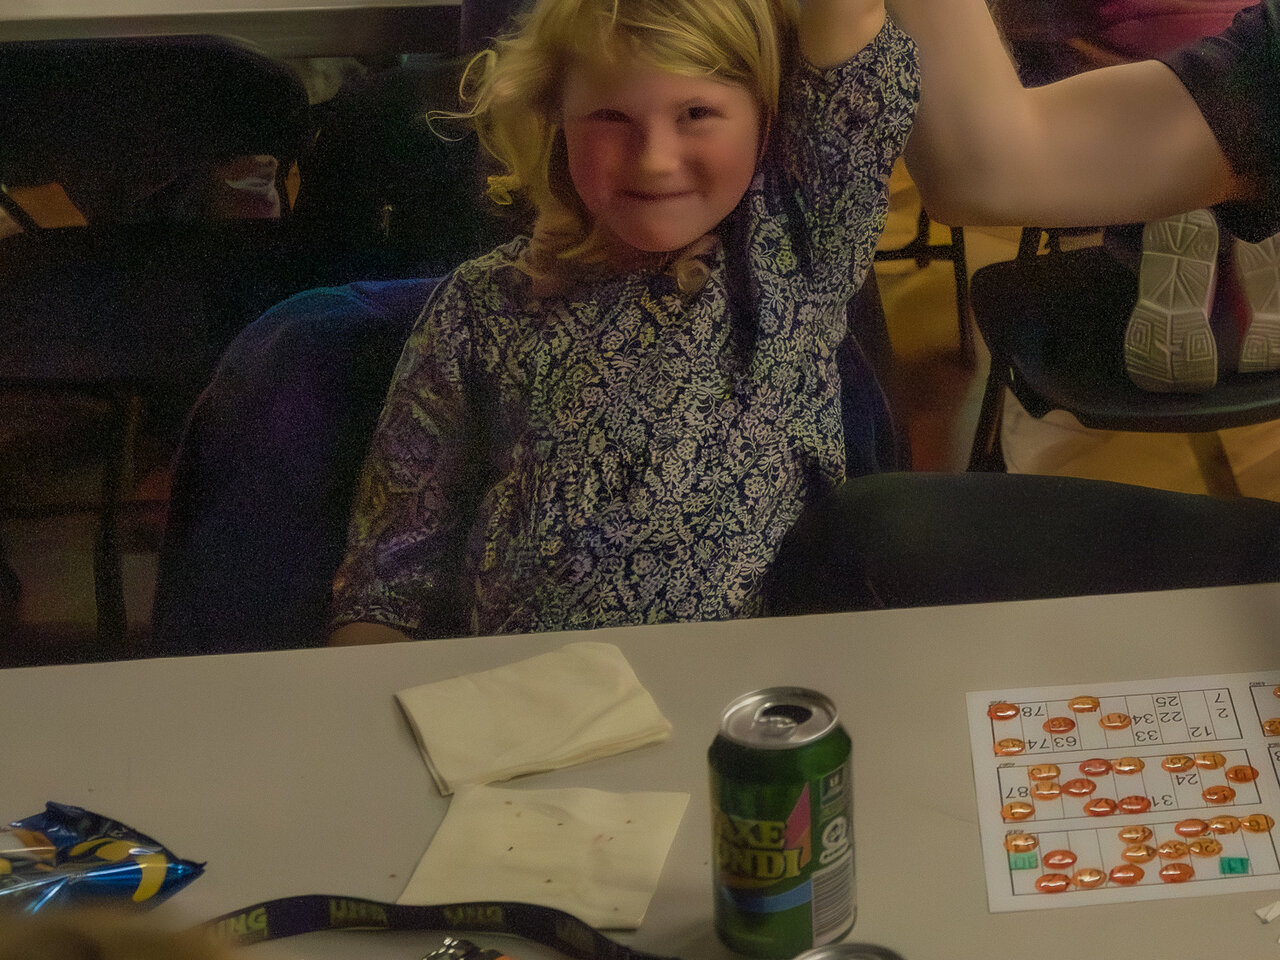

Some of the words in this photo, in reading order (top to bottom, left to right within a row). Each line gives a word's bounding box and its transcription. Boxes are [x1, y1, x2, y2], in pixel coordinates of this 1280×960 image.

[1155, 696, 1179, 708] 25
[1214, 692, 1225, 704] 7
[1021, 706, 1045, 718] 78
[1159, 711, 1183, 723] 22
[1216, 708, 1229, 718] 2
[1132, 713, 1154, 726] 34
[1135, 730, 1159, 742] 33
[1189, 725, 1212, 738] 12
[1028, 738, 1050, 750] 74
[1054, 736, 1077, 748] 63
[1176, 773, 1198, 786] 24
[1005, 786, 1029, 799] 87
[1150, 794, 1174, 807] 31
